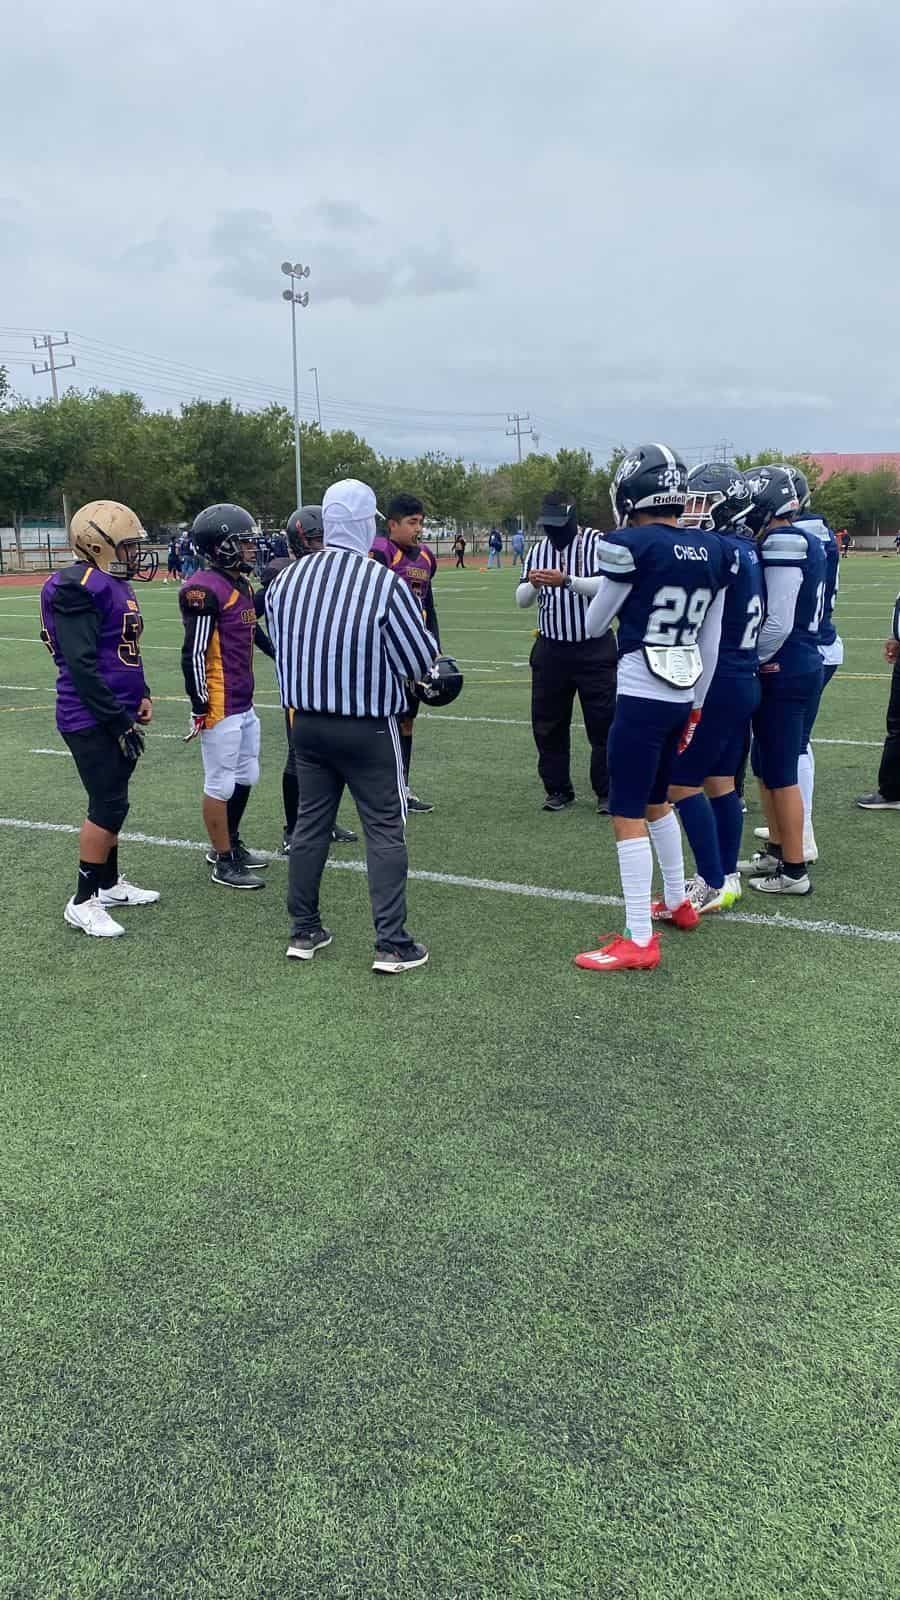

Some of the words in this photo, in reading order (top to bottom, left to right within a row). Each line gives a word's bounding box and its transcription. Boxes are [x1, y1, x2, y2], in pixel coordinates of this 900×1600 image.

[664, 470, 681, 486] 29
[673, 544, 708, 561] CHELO
[642, 585, 712, 645] 29
